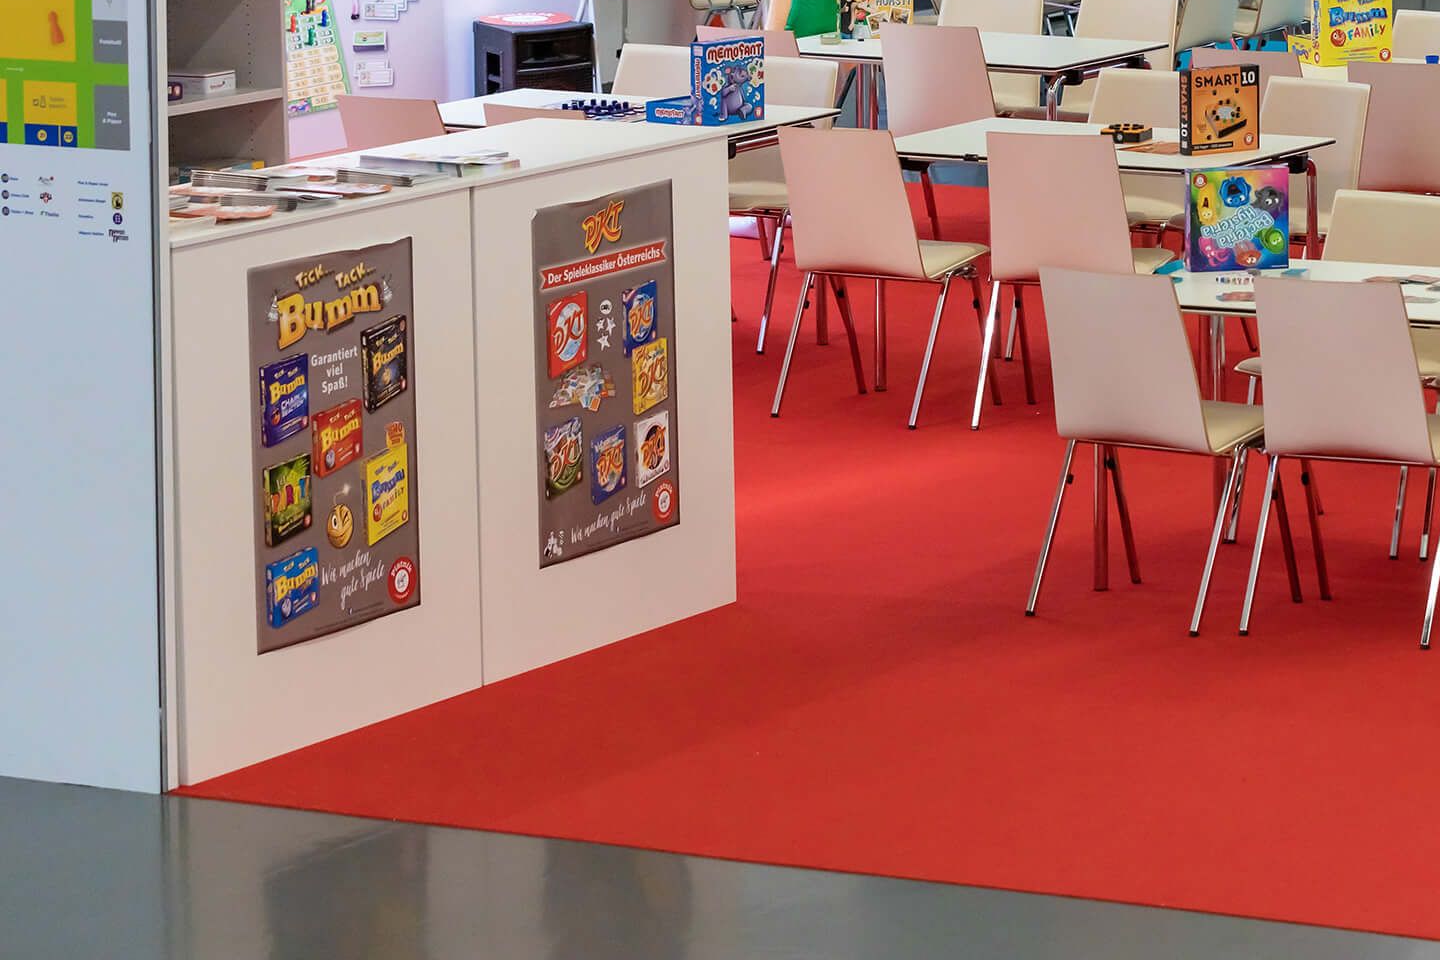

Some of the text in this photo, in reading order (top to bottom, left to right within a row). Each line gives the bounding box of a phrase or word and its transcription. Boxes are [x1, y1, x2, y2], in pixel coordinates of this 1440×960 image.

[1328, 6, 1388, 27] Bumm
[706, 41, 762, 64] MEMOFANT
[1195, 71, 1256, 89] SMART 10
[1180, 75, 1189, 137] SMART 10
[582, 200, 624, 254] DKT
[1202, 205, 1256, 238] Hysteria
[1218, 211, 1275, 249] Bacteria
[547, 246, 661, 285] Der Spieleklassiker Österreichs
[277, 283, 383, 350] Bumm
[311, 345, 358, 367] Garantiert
[326, 363, 343, 378] viel
[373, 342, 404, 377] Bumm
[269, 374, 305, 406] Bumm
[321, 375, 348, 396] Spaß!
[321, 417, 360, 453] Bumm
[571, 491, 647, 545] Wir machen gute Spiele
[275, 565, 318, 602] Bumm
[321, 549, 372, 587] Wir machen
[340, 560, 385, 611] gute Spiele
